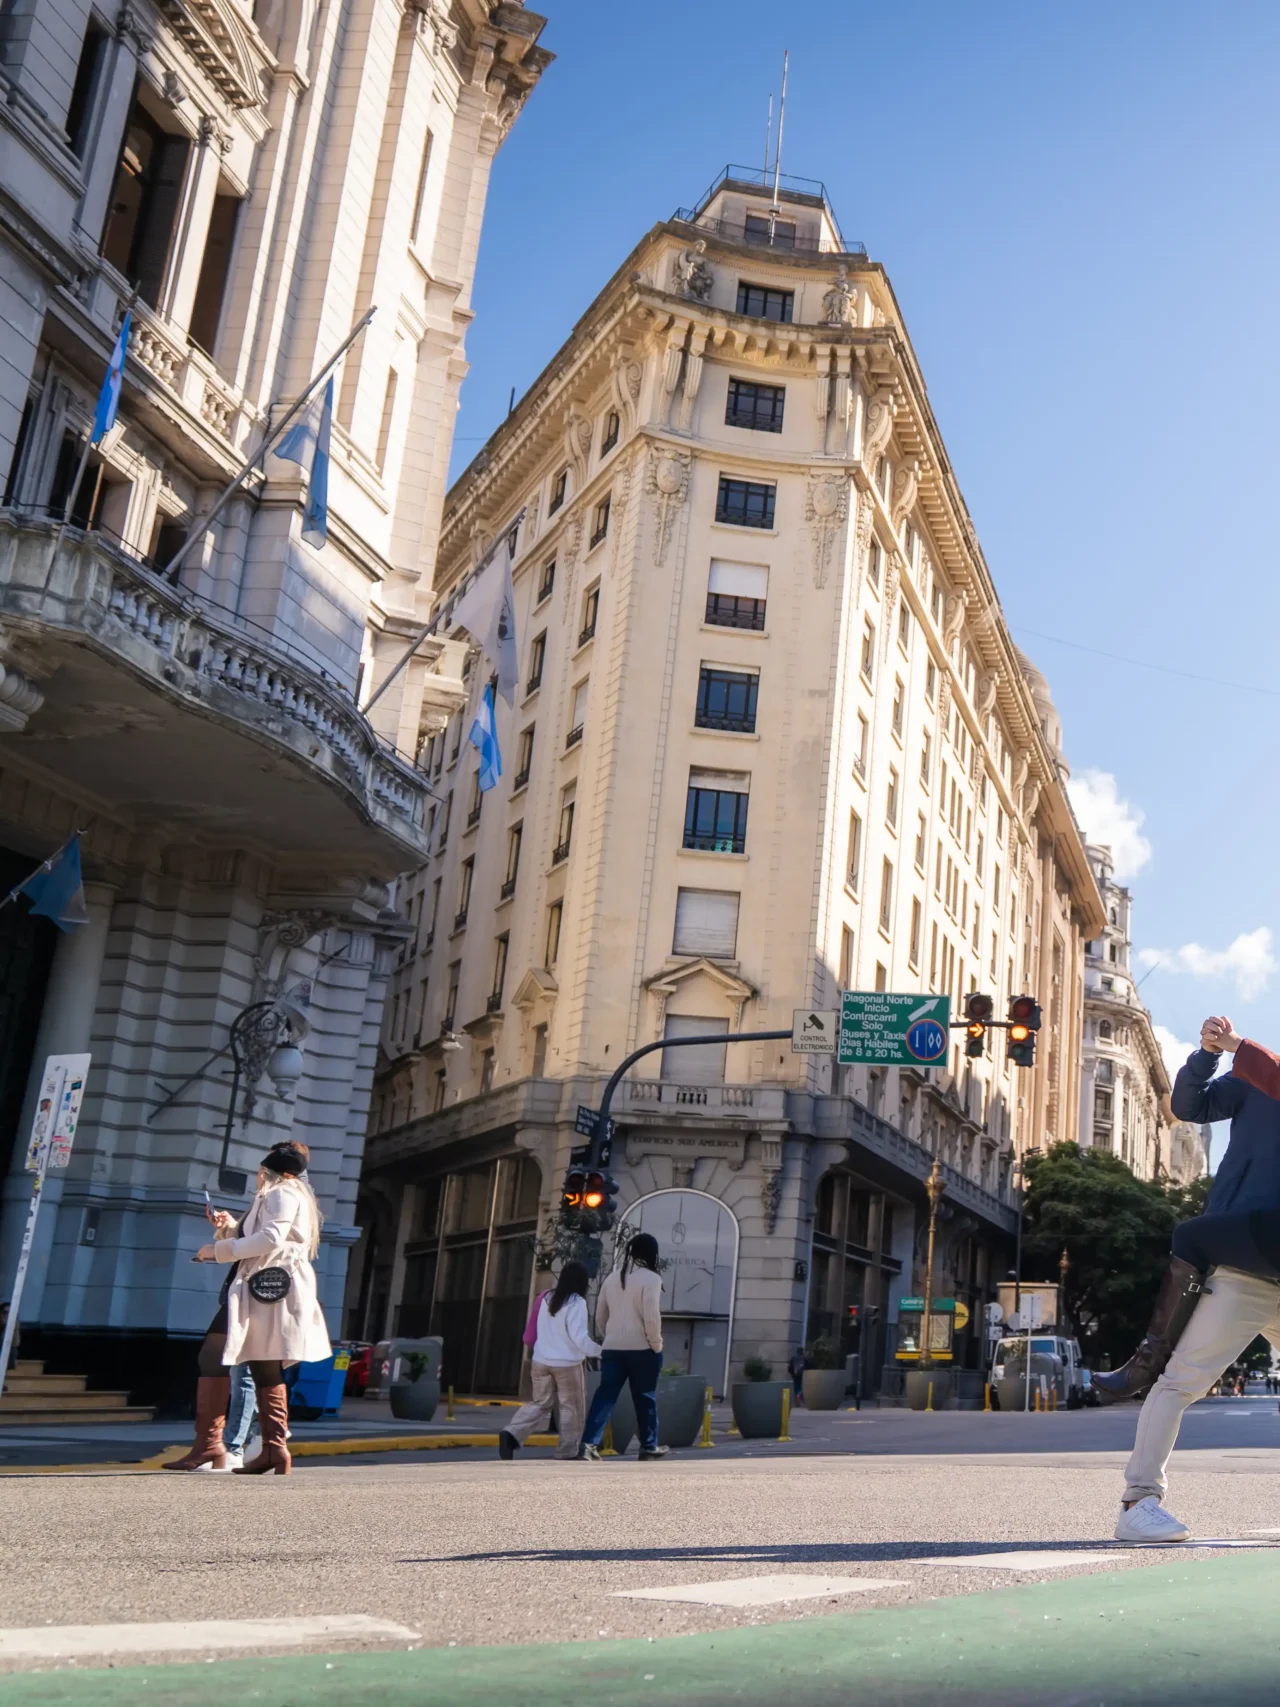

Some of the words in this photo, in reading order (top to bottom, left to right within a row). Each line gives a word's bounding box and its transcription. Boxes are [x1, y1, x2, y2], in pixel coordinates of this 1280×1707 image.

[843, 993, 884, 1004] Diagonal
[887, 995, 914, 1005] Norte
[864, 1003, 890, 1013] Inicio
[842, 1011, 897, 1022] Contracarril
[862, 1021, 883, 1030] Solo
[841, 1029, 870, 1038] Buses
[874, 1032, 880, 1040] y
[882, 1030, 906, 1040] Taxis
[793, 1043, 834, 1051] ELECTRONICO
[840, 1047, 852, 1056] de
[855, 1047, 863, 1056] 8
[874, 1049, 888, 1058] 20
